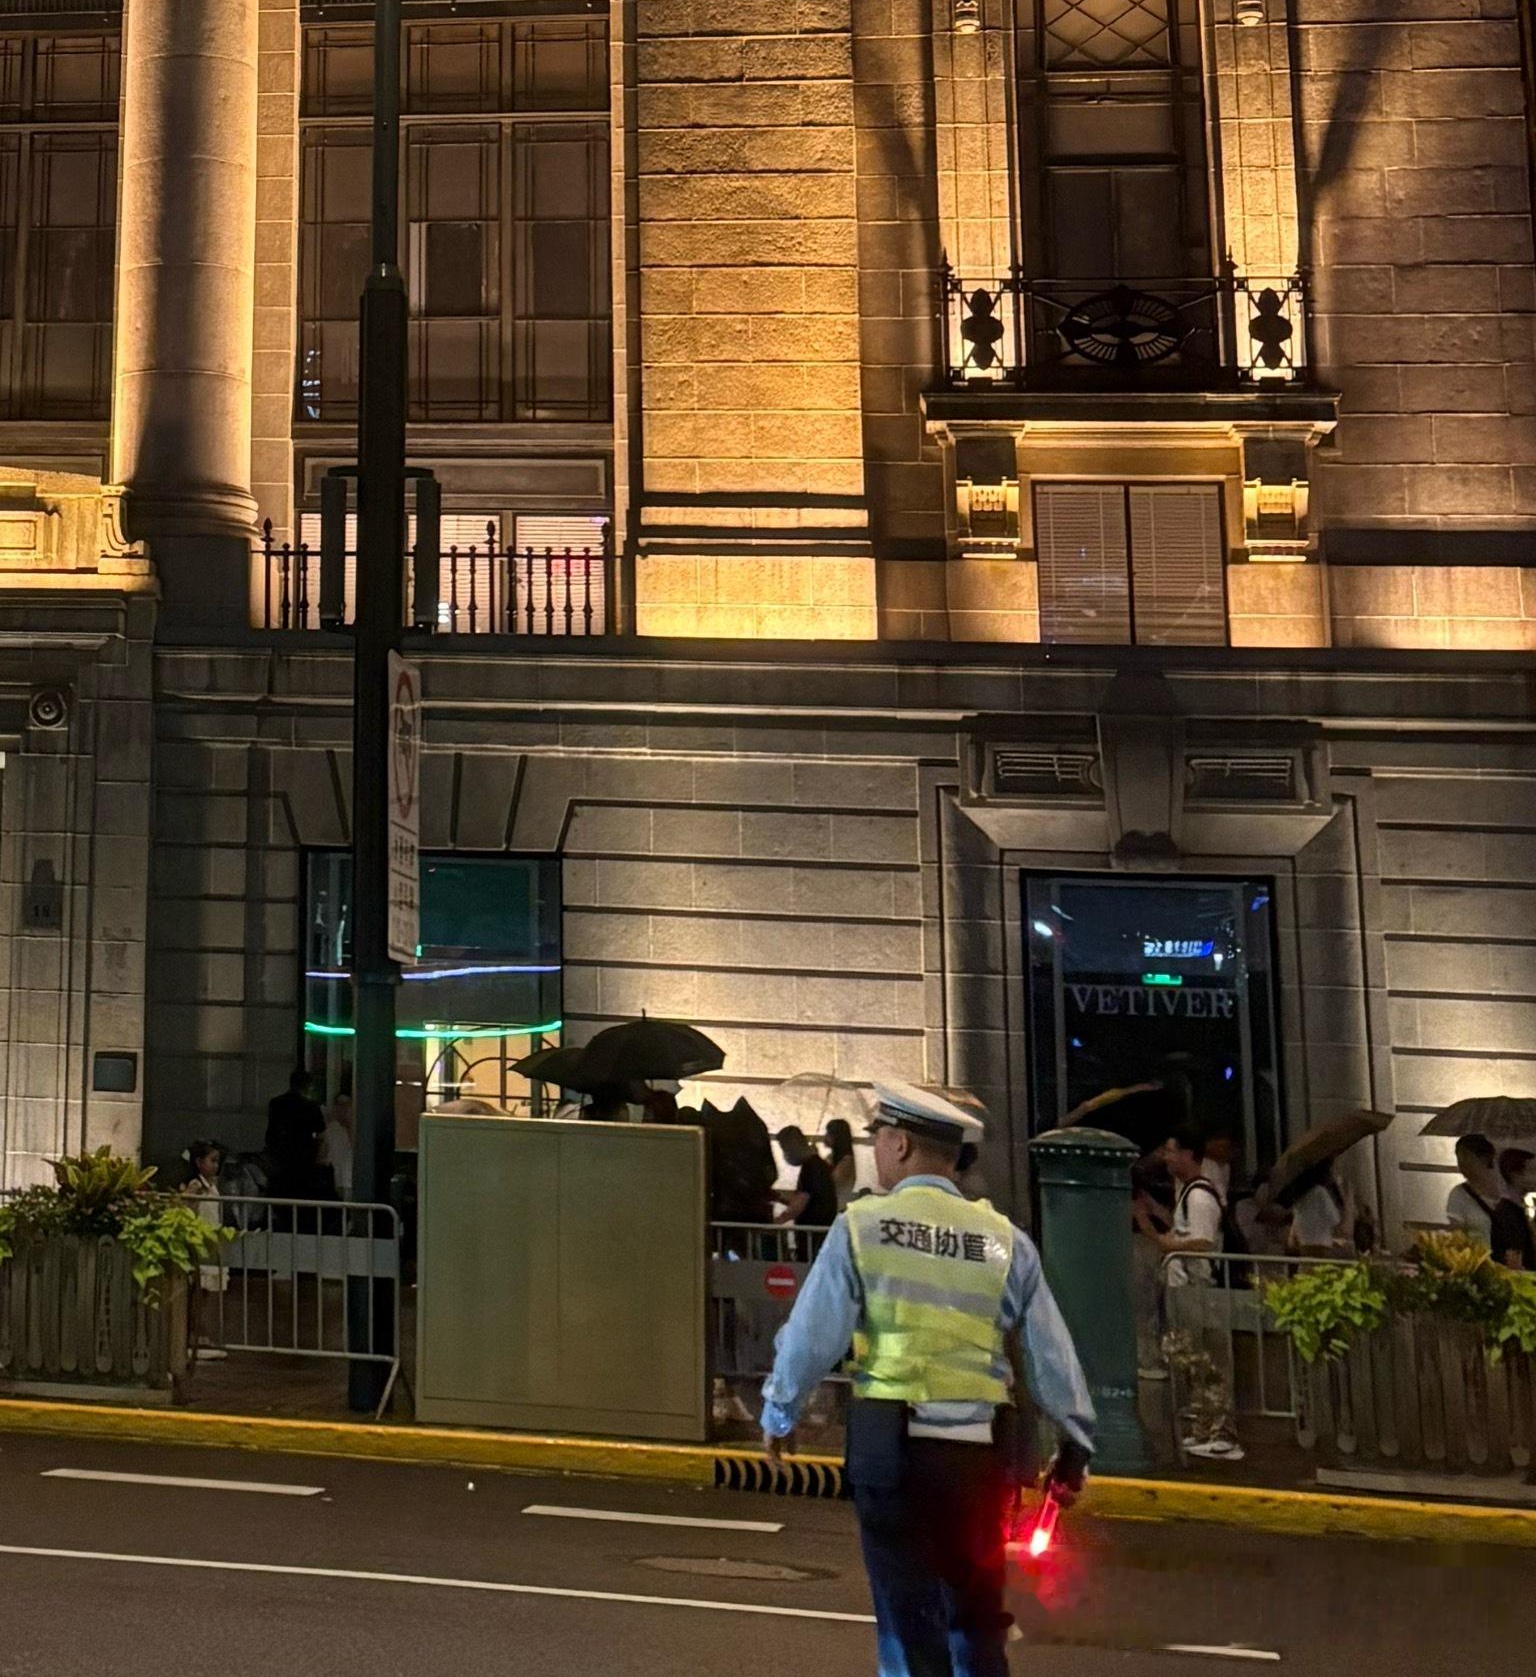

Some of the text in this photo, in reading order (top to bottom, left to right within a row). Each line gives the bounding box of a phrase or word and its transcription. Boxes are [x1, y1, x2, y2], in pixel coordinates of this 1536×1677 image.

[1069, 984, 1234, 1019] VETIVER
[879, 1217, 987, 1263] 交通协管
